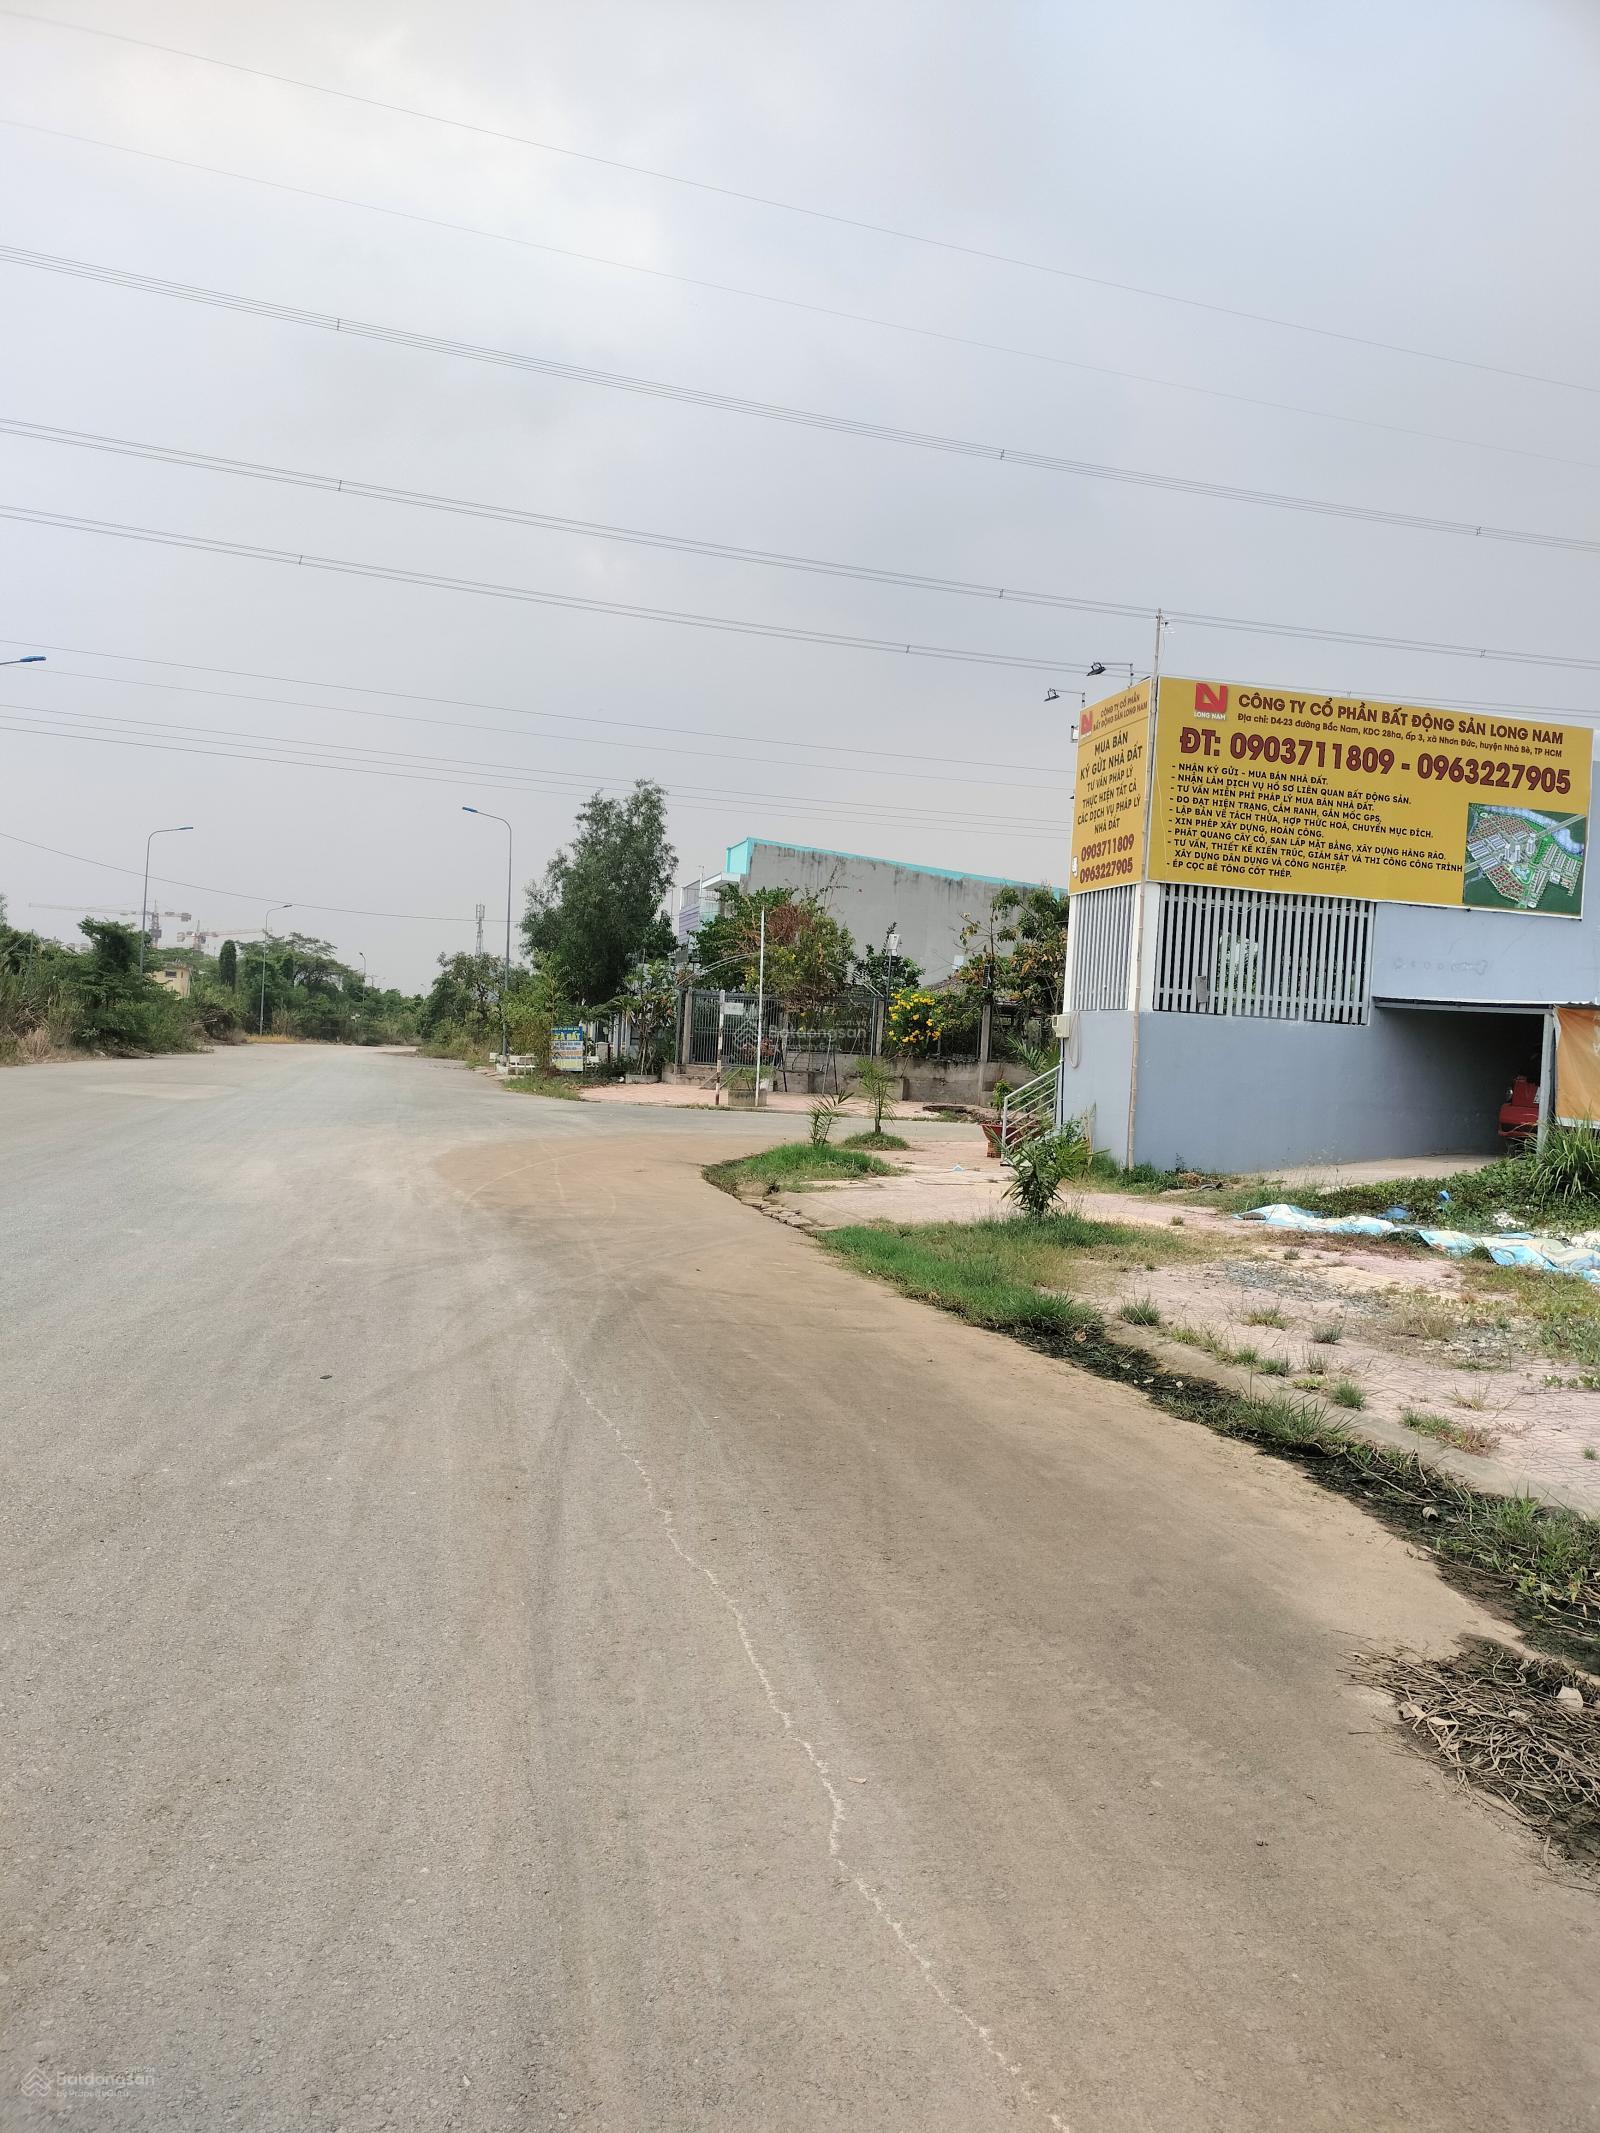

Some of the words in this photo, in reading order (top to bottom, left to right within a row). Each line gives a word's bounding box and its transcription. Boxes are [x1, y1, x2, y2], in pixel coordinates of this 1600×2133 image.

[1193, 711, 1210, 719] LONG
[1211, 713, 1226, 721] NAM
[1238, 692, 1286, 712] CÔNG
[1289, 699, 1306, 714] TY
[1310, 697, 1333, 717] CỔ
[1337, 701, 1377, 723] PHẦN
[1381, 707, 1408, 726] BẤT
[1411, 712, 1455, 732] ĐỘNG
[1458, 717, 1486, 736] SẢN
[1490, 724, 1529, 740] LONG
[1532, 729, 1563, 745] NAM
[1094, 739, 1110, 756] MUA
[1112, 730, 1128, 748] BÁN
[1237, 713, 1252, 723] Địa
[1253, 714, 1269, 724] chỉ:
[1270, 716, 1293, 726] D4-23
[1295, 719, 1321, 731] đường
[1322, 721, 1338, 732] Bắc
[1340, 724, 1361, 735] Nam,
[1363, 727, 1380, 736] KDC
[1382, 729, 1404, 740] 28ha,
[1405, 731, 1416, 742] ấp
[1418, 733, 1425, 743] 3,
[1439, 736, 1459, 745] Nhơn
[1460, 738, 1478, 749] Đức,
[1479, 741, 1502, 752] huyện
[1521, 745, 1532, 755] Bè,
[1534, 747, 1543, 755] TP
[1544, 748, 1562, 758] HCM
[1080, 762, 1090, 781] KÝ
[1108, 748, 1125, 769] NHÀ
[1126, 740, 1143, 762] ĐẤT
[1178, 762, 1204, 775] NHẬN
[1207, 764, 1219, 774] KÝ
[1221, 766, 1239, 776] GỬI
[1248, 770, 1267, 779] MUA
[1269, 771, 1287, 781] BÁN
[1289, 774, 1308, 783] NHÀ
[1310, 774, 1328, 785] ĐẤT.
[1179, 726, 1221, 757] ĐT:
[1230, 732, 1395, 775] 0903711809
[1417, 752, 1571, 794] 0963227905
[1087, 779, 1095, 792] TƯ
[1108, 768, 1125, 784] PHÁP
[1126, 764, 1134, 778] LÝ
[1178, 773, 1203, 786] NHẬN
[1206, 775, 1224, 786] LÀM
[1226, 778, 1250, 789] DỊCH
[1252, 781, 1264, 791] VỤ
[1267, 780, 1280, 791] HỒ
[1282, 784, 1295, 792] SƠ
[1297, 785, 1318, 795] LIÊN
[1320, 788, 1345, 798] QUAN
[1347, 788, 1364, 799] BẤT
[1365, 791, 1390, 803] ĐỘNG
[1392, 794, 1412, 805] SẢN.
[1089, 807, 1105, 823] DỊCH
[1115, 797, 1132, 813] PHÁP
[1133, 793, 1141, 808] LÝ
[1176, 795, 1190, 804] ĐO
[1192, 797, 1210, 808] ĐẠT
[1237, 801, 1270, 814] TRẠNG,
[1293, 807, 1319, 818] RANH,
[1342, 809, 1361, 821] MỐC
[1177, 784, 1190, 793] TƯ
[1192, 782, 1209, 795] VẤN
[1212, 786, 1236, 797] MIỄN
[1238, 790, 1255, 799] PHÍ
[1258, 792, 1281, 802] PHÁP
[1283, 793, 1293, 803] LÝ
[1295, 796, 1314, 805] MUA
[1316, 797, 1334, 807] BÁN
[1336, 800, 1354, 809] NHÀ
[1356, 800, 1375, 811] ĐẤT.
[1175, 817, 1192, 826] XIN
[1195, 818, 1218, 828] PHÉP
[1220, 820, 1237, 830] XÂY
[1240, 823, 1268, 835] DỰNG,
[1270, 825, 1295, 835] HOÀN
[1297, 827, 1324, 838] CÔNG.
[1176, 805, 1192, 816] LẬP
[1195, 807, 1213, 817] BẢN
[1229, 810, 1252, 820] TÁCH
[1283, 816, 1301, 827] HỢP
[1303, 818, 1327, 828] THỨC
[1352, 822, 1386, 834] CHUYỂN
[1389, 826, 1407, 837] MỤC
[1409, 827, 1434, 838] ĐÍCH.
[1081, 833, 1135, 862] 0903711809
[1174, 827, 1198, 837] PHÁT
[1200, 830, 1232, 840] QUANG
[1234, 832, 1251, 842] CÂY
[1253, 834, 1268, 845] CỎ,
[1270, 836, 1287, 845] SAN
[1290, 836, 1306, 847] LẤP
[1308, 839, 1326, 851] MẶT
[1328, 839, 1354, 853] BẰNG,
[1356, 843, 1373, 853] XÂY
[1374, 846, 1399, 857] DỰNG
[1401, 848, 1425, 858] HÀNG
[1174, 838, 1186, 847] TƯ
[1188, 837, 1208, 850] VẤN,
[1211, 841, 1239, 852] THIẾT
[1241, 842, 1253, 853] KẾ
[1255, 843, 1278, 855] KIẾN
[1280, 847, 1305, 859] TRÚC,
[1308, 850, 1331, 860] GIÁM
[1333, 851, 1350, 862] SÁT
[1351, 853, 1362, 863] VÀ
[1364, 856, 1381, 865] THI
[1383, 855, 1407, 867] CÔNG
[1409, 859, 1434, 869] CÔNG
[1436, 862, 1463, 872] TRÌNH
[1079, 856, 1133, 884] 0963227905
[1172, 858, 1184, 868] ÉP
[1186, 861, 1205, 872] CỌC
[1206, 862, 1218, 872] BÊ
[1220, 863, 1246, 874] TÔNG
[1248, 863, 1266, 876] CỐT
[1268, 867, 1292, 878] THÉP.
[1174, 848, 1192, 858] XÂY
[1194, 851, 1220, 863] DỰNG
[1222, 852, 1241, 863] DÂN
[1243, 856, 1269, 867] DỤNG
[1271, 856, 1282, 866] VÀ
[1284, 858, 1309, 869] CÔNG
[1312, 862, 1347, 874] NGHIỆP.
